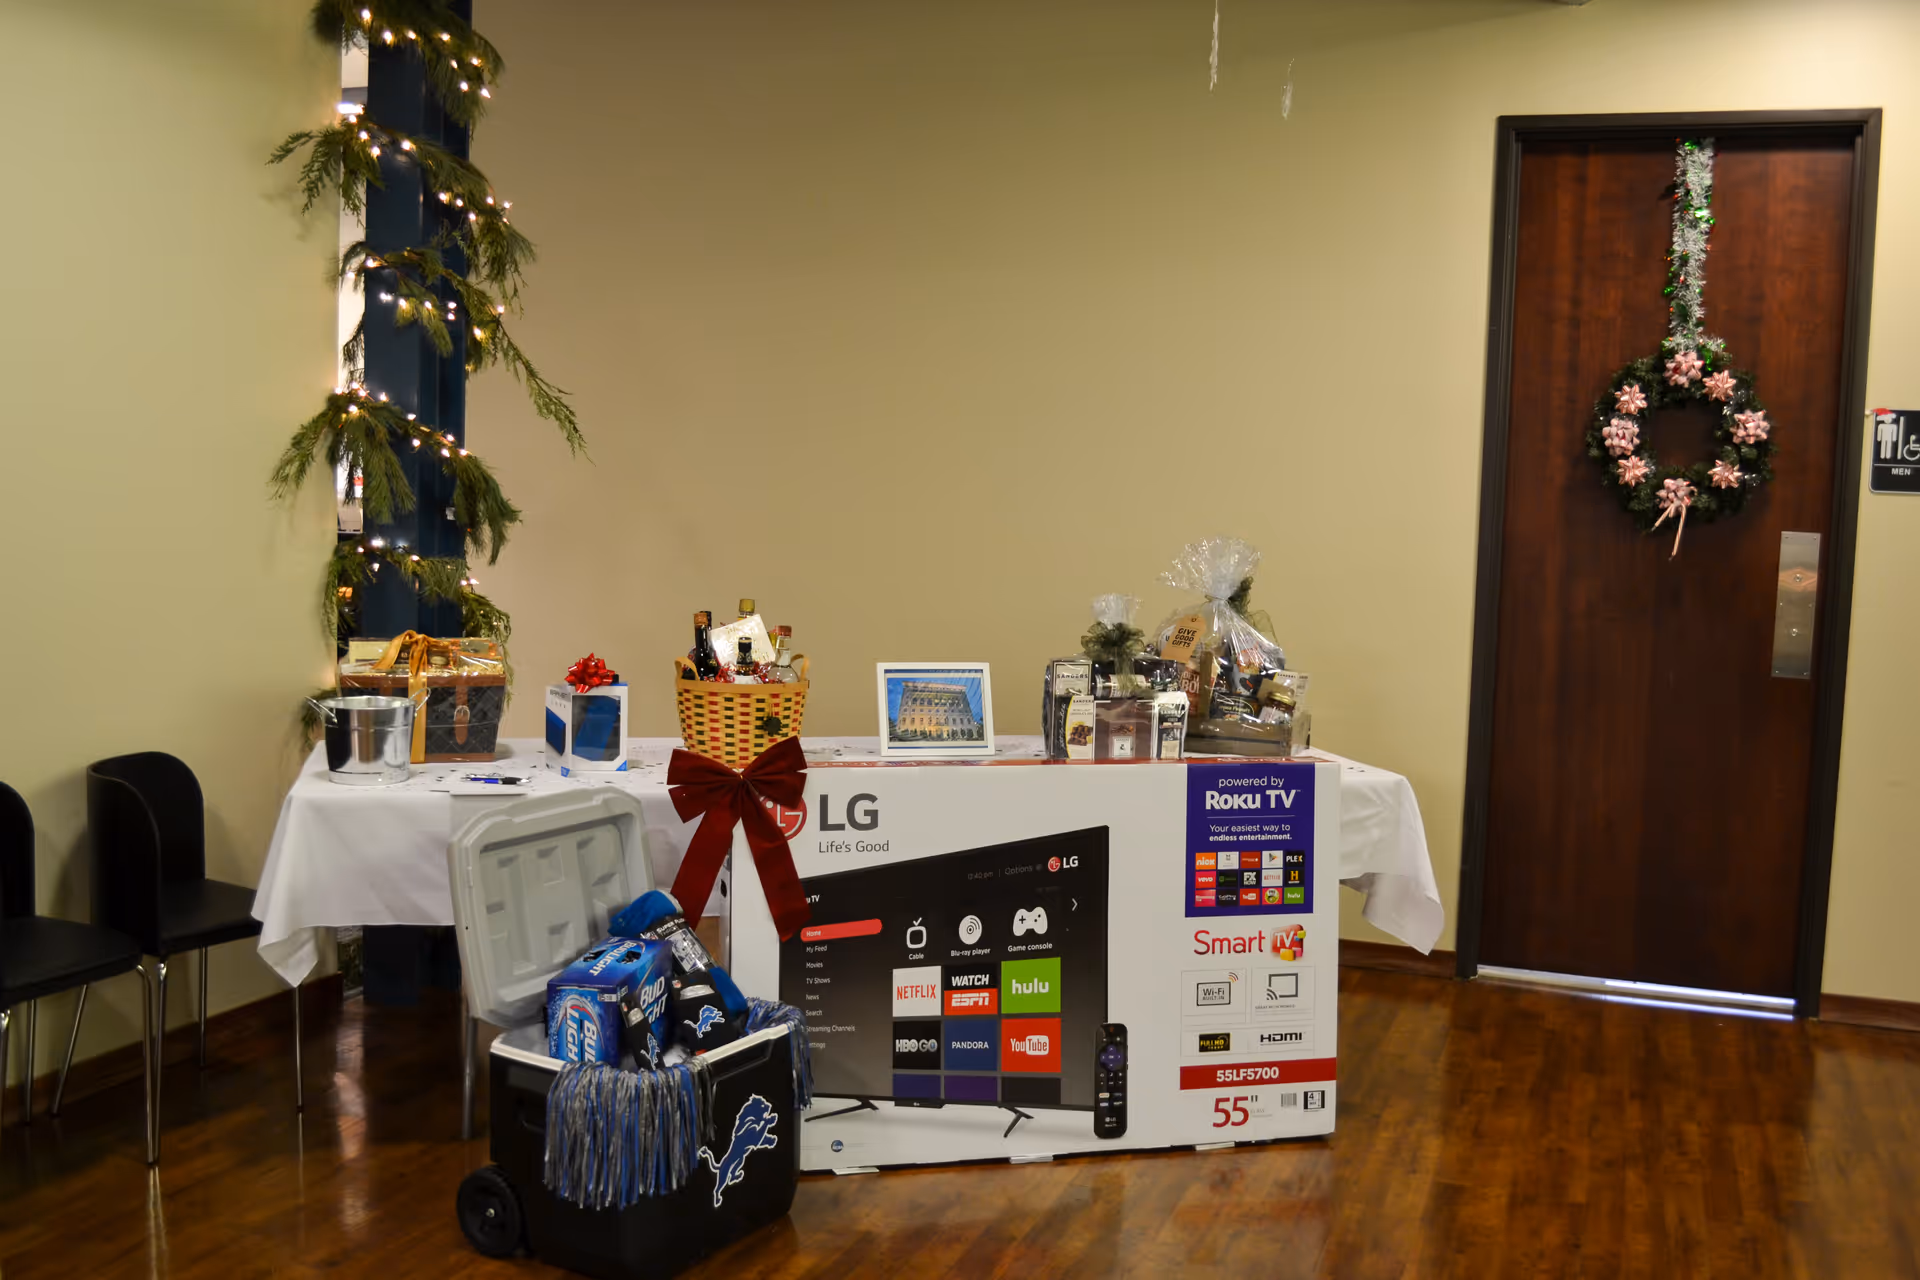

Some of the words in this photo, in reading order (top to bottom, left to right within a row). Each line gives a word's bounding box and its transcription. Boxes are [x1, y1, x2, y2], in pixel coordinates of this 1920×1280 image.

[1891, 467, 1911, 475] MEN
[1174, 634, 1195, 642] GOOD
[1177, 628, 1197, 637] GIVE
[1171, 640, 1192, 648] GIFTS
[1218, 776, 1268, 788] powered
[1270, 776, 1285, 788] by
[819, 793, 879, 832] LG
[1209, 825, 1229, 833] Your
[1231, 824, 1260, 832] easiest
[1262, 824, 1280, 833] way
[1281, 824, 1291, 832] to
[1209, 834, 1237, 842] endless
[1238, 833, 1292, 841] entertainment.
[818, 840, 851, 853] Life's
[855, 840, 889, 852] Good
[1062, 856, 1079, 868] LG
[1004, 864, 1033, 875] Options
[1243, 872, 1257, 880] FX
[811, 895, 820, 903] TV
[806, 929, 822, 937] Home
[1193, 929, 1266, 955] Smart
[1274, 931, 1296, 948] TV
[806, 946, 814, 954] My
[950, 949, 971, 957] Blu-ray
[971, 947, 991, 956] player
[1007, 944, 1027, 952] Game
[1027, 942, 1053, 950] console
[951, 974, 990, 987] WATCH
[1011, 978, 1049, 994] hulu
[641, 976, 665, 1010] BUD
[896, 984, 937, 1000] NETFLIX
[1202, 987, 1225, 996] Wi-Fi
[951, 992, 990, 1007] ESPN
[645, 992, 668, 1024] GHT
[805, 1025, 831, 1033] Streaming
[832, 1024, 856, 1032] Channels
[566, 1007, 580, 1062] LIGH
[1260, 1032, 1303, 1043] HDMI
[895, 1039, 918, 1052] HBO
[918, 1038, 938, 1052] GO
[951, 1041, 989, 1049] PANDORA
[1010, 1037, 1049, 1054] YouTube
[1216, 1066, 1279, 1082] 55LF5700
